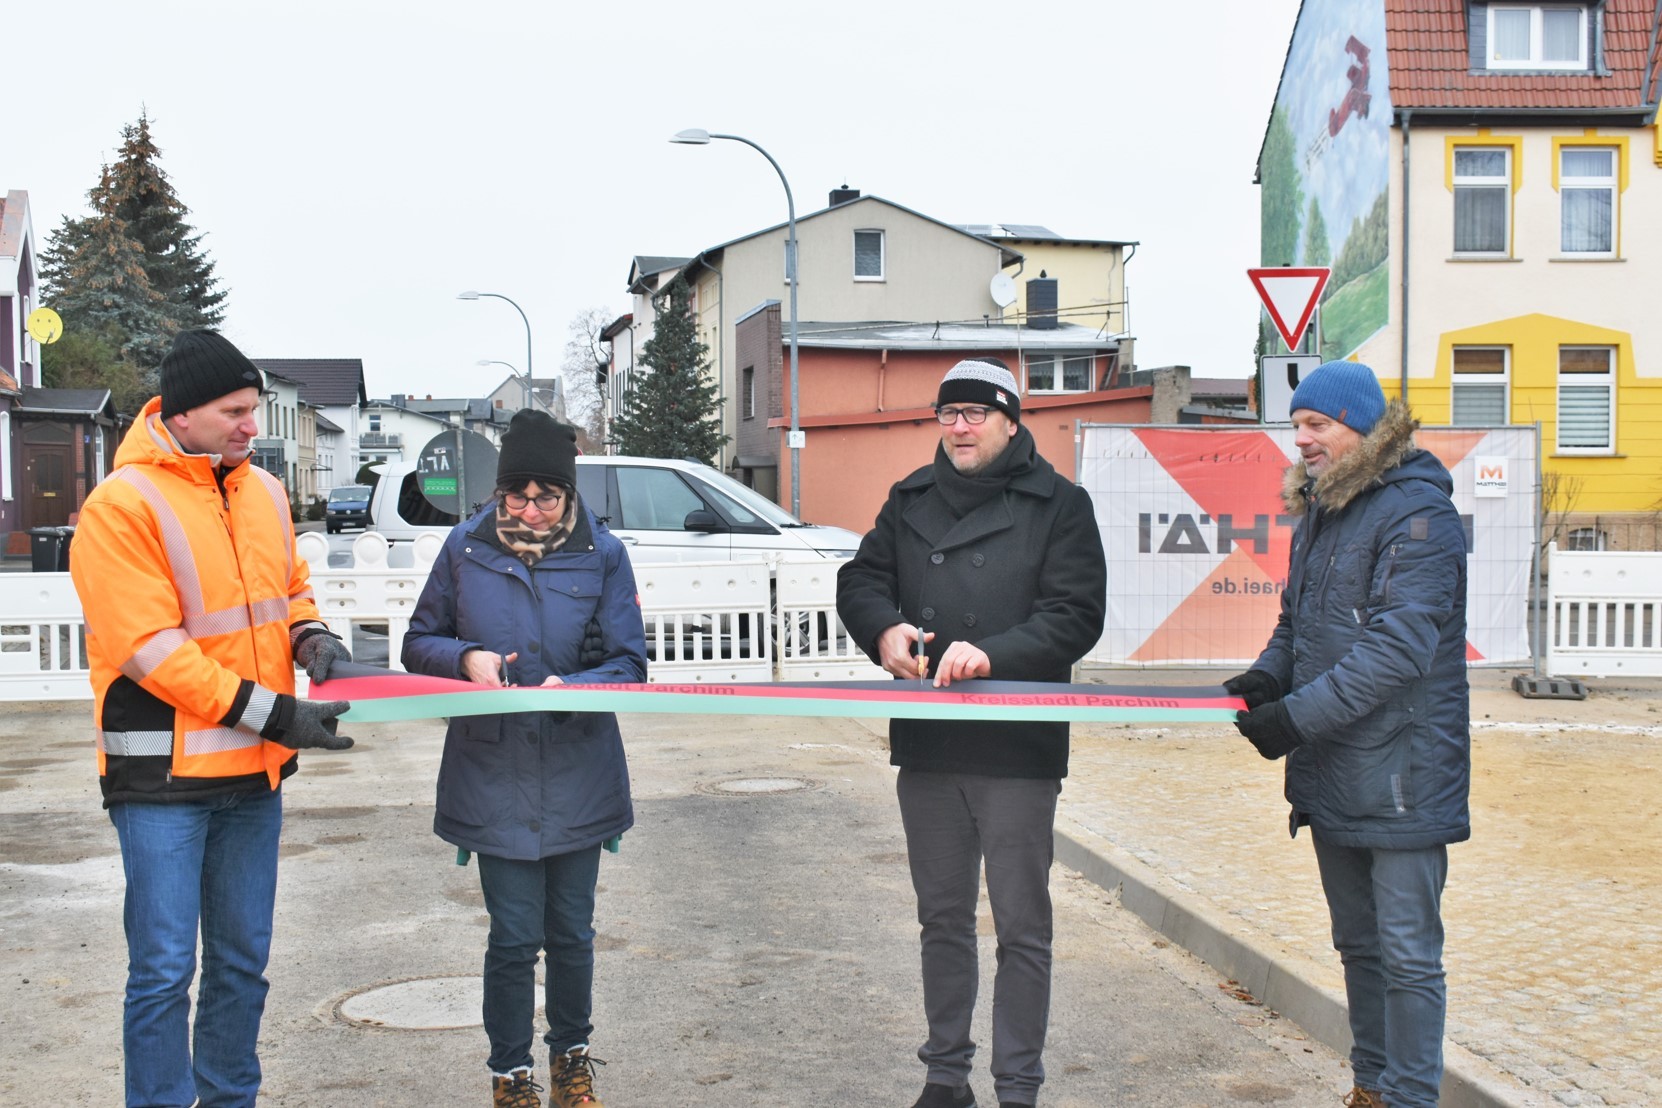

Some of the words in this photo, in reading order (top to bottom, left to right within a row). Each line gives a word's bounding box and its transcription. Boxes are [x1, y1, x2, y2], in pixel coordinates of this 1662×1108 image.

[639, 684, 735, 696] Parchim
[961, 693, 1080, 706] Kreisstadt
[1085, 695, 1180, 708] Parchim
